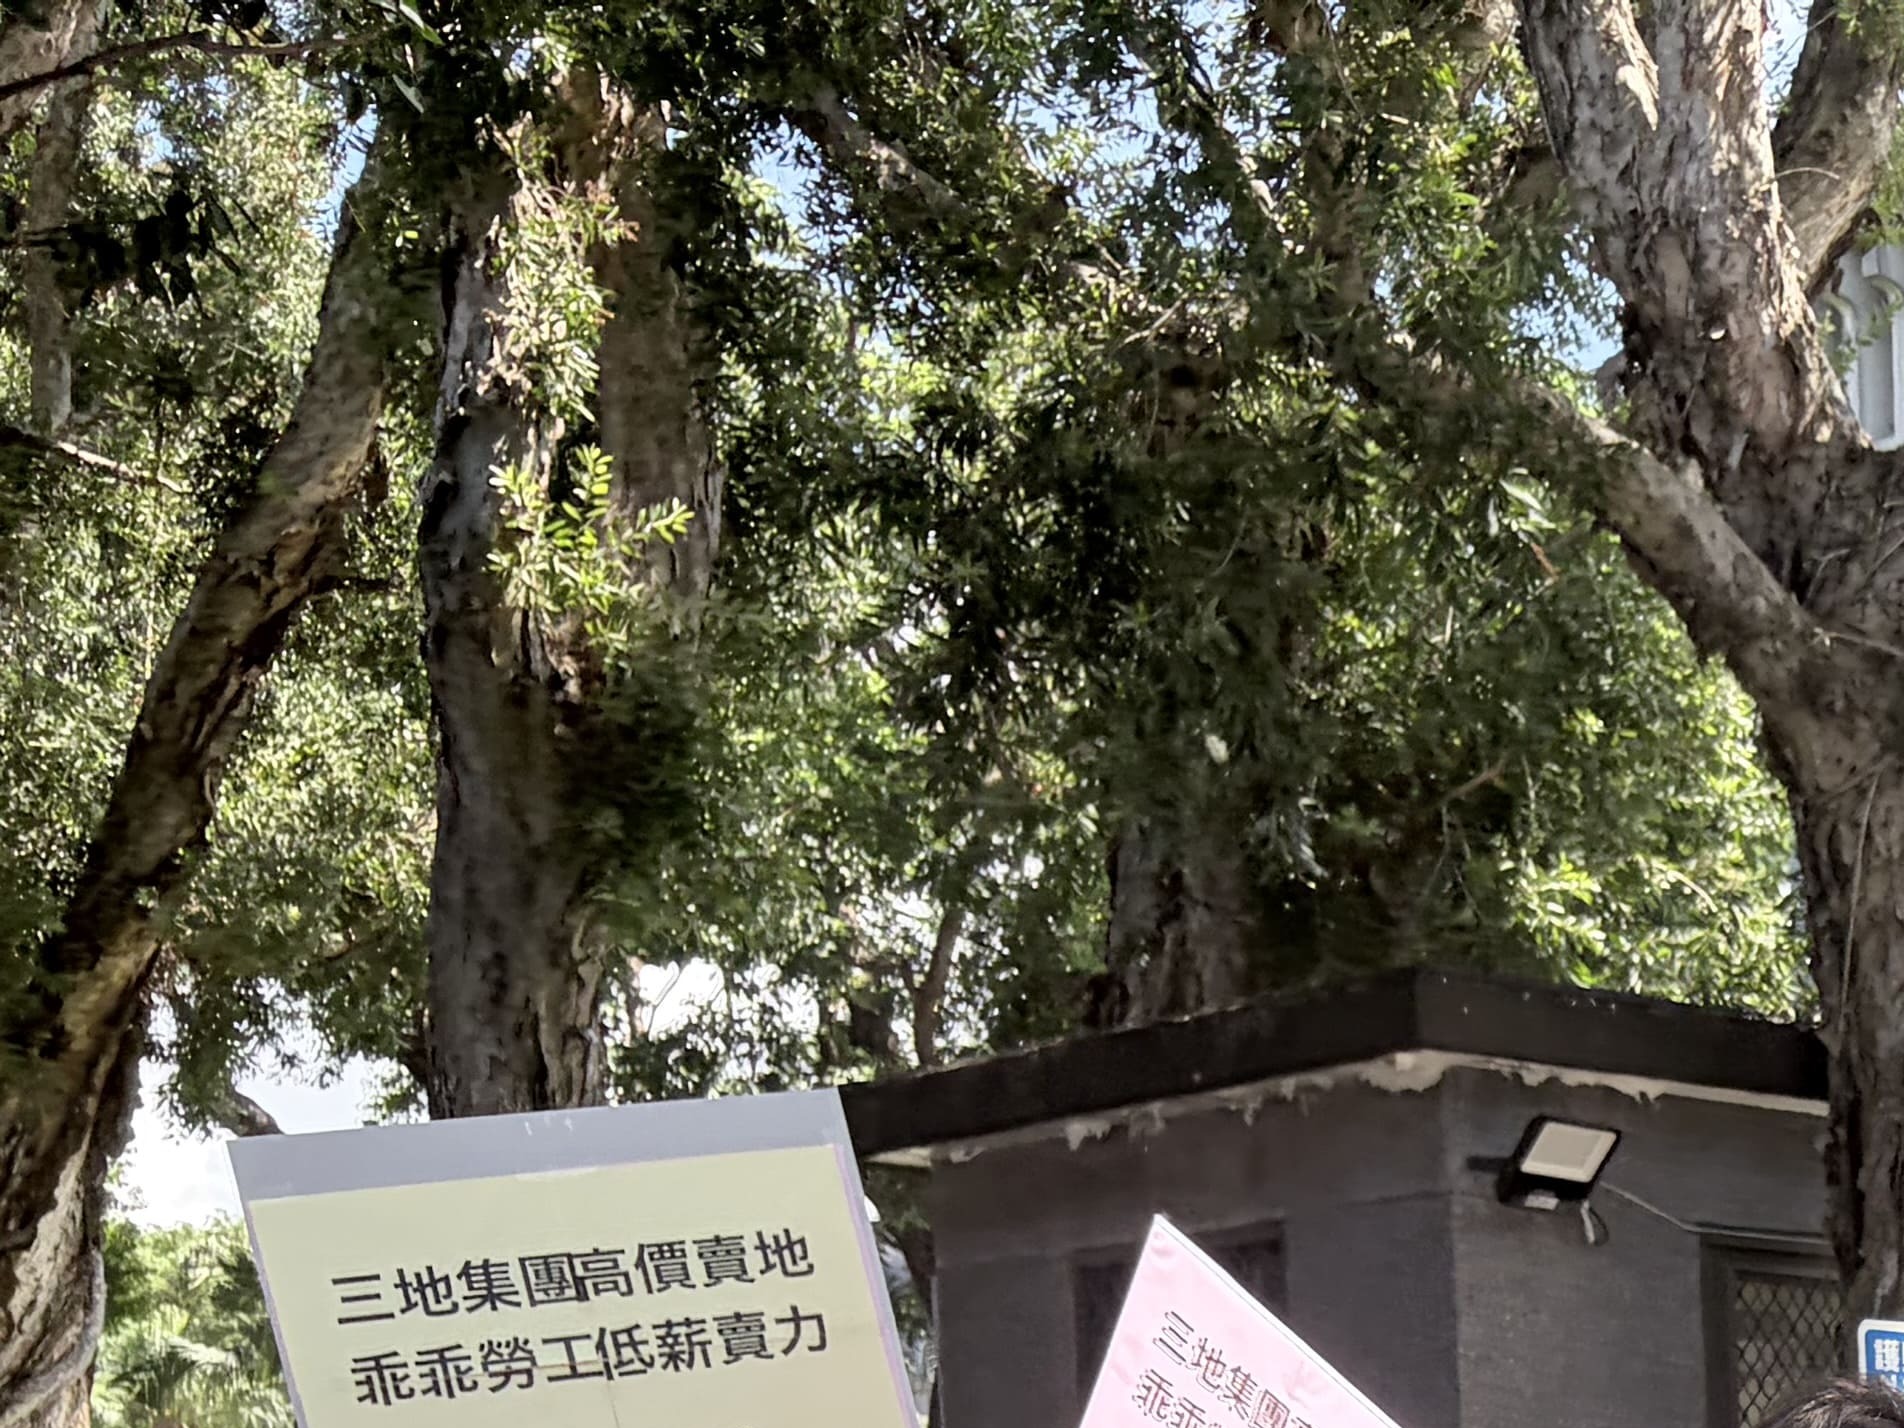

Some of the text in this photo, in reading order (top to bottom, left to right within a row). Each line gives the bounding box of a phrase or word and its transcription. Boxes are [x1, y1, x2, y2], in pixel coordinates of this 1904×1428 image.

[331, 1228, 817, 1325] 三地集團高價賣地
[351, 1305, 828, 1407] 乖乖勞工低薪賣力
